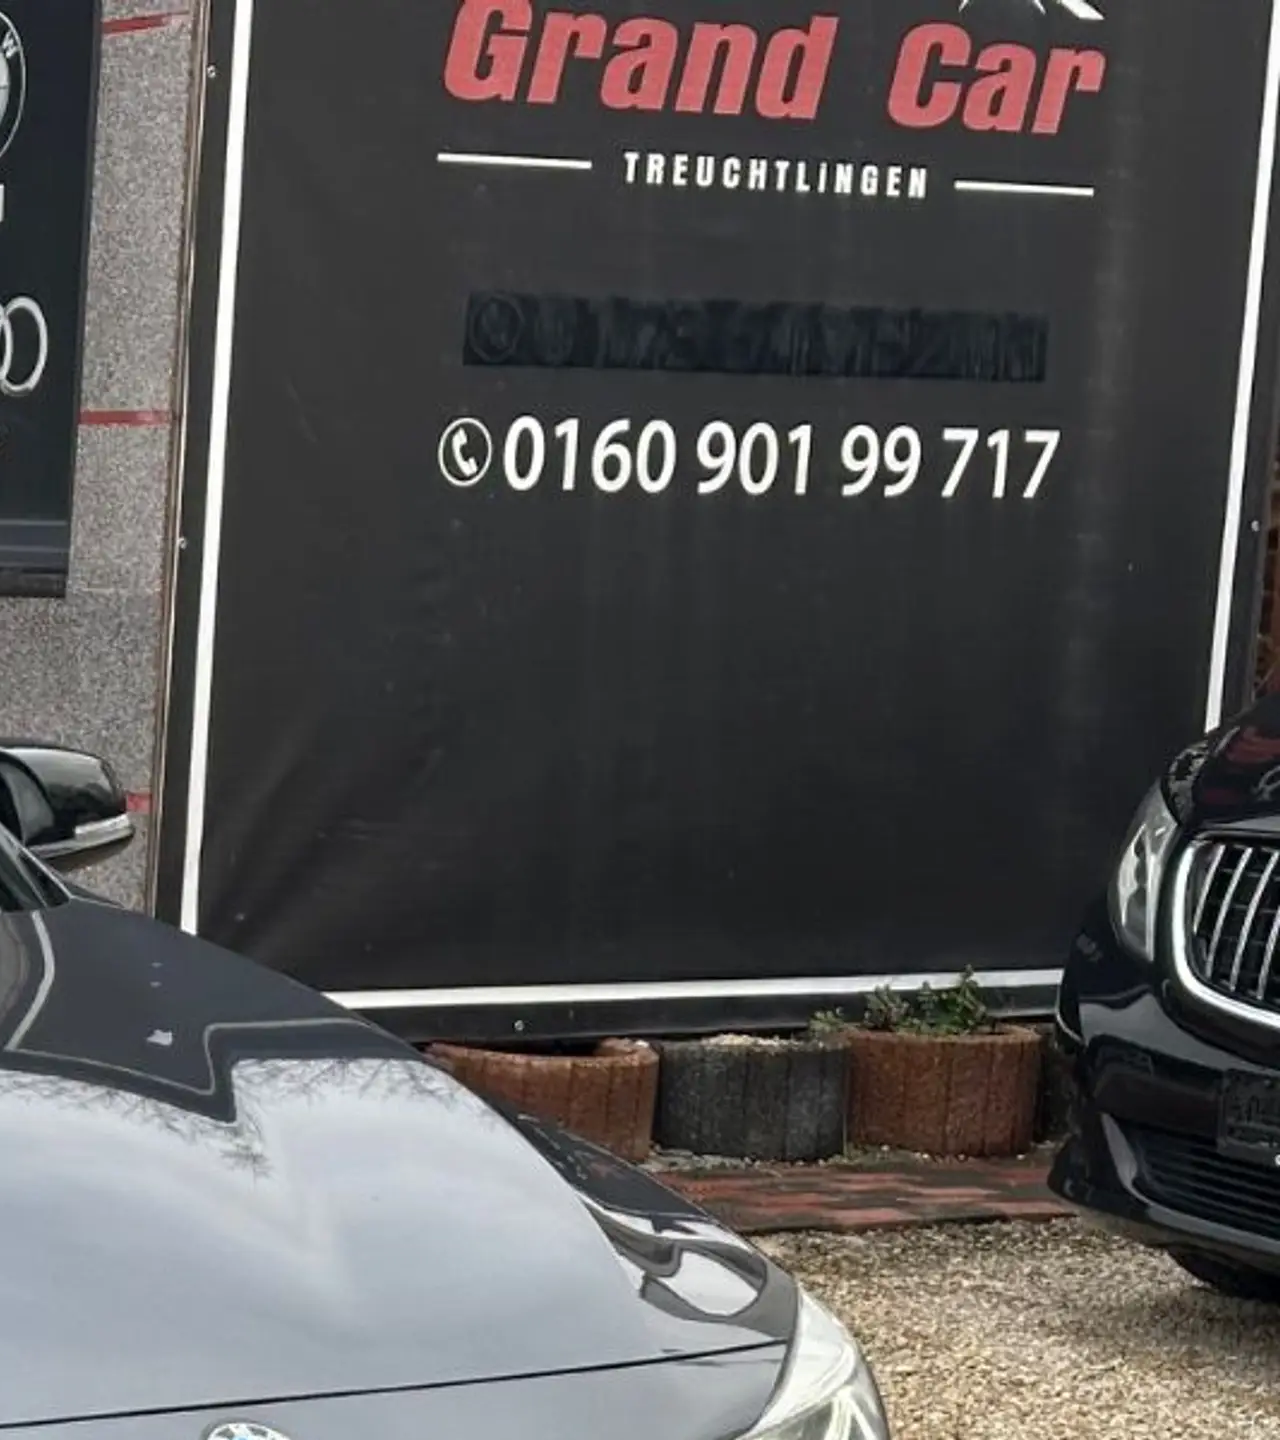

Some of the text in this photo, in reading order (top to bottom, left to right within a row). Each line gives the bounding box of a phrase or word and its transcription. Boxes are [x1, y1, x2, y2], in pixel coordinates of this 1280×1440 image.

[444, 0, 1104, 133] Grand Car
[624, 151, 928, 199] TREUCHTLINGEN
[503, 415, 1062, 499] 0160 901 99 717
